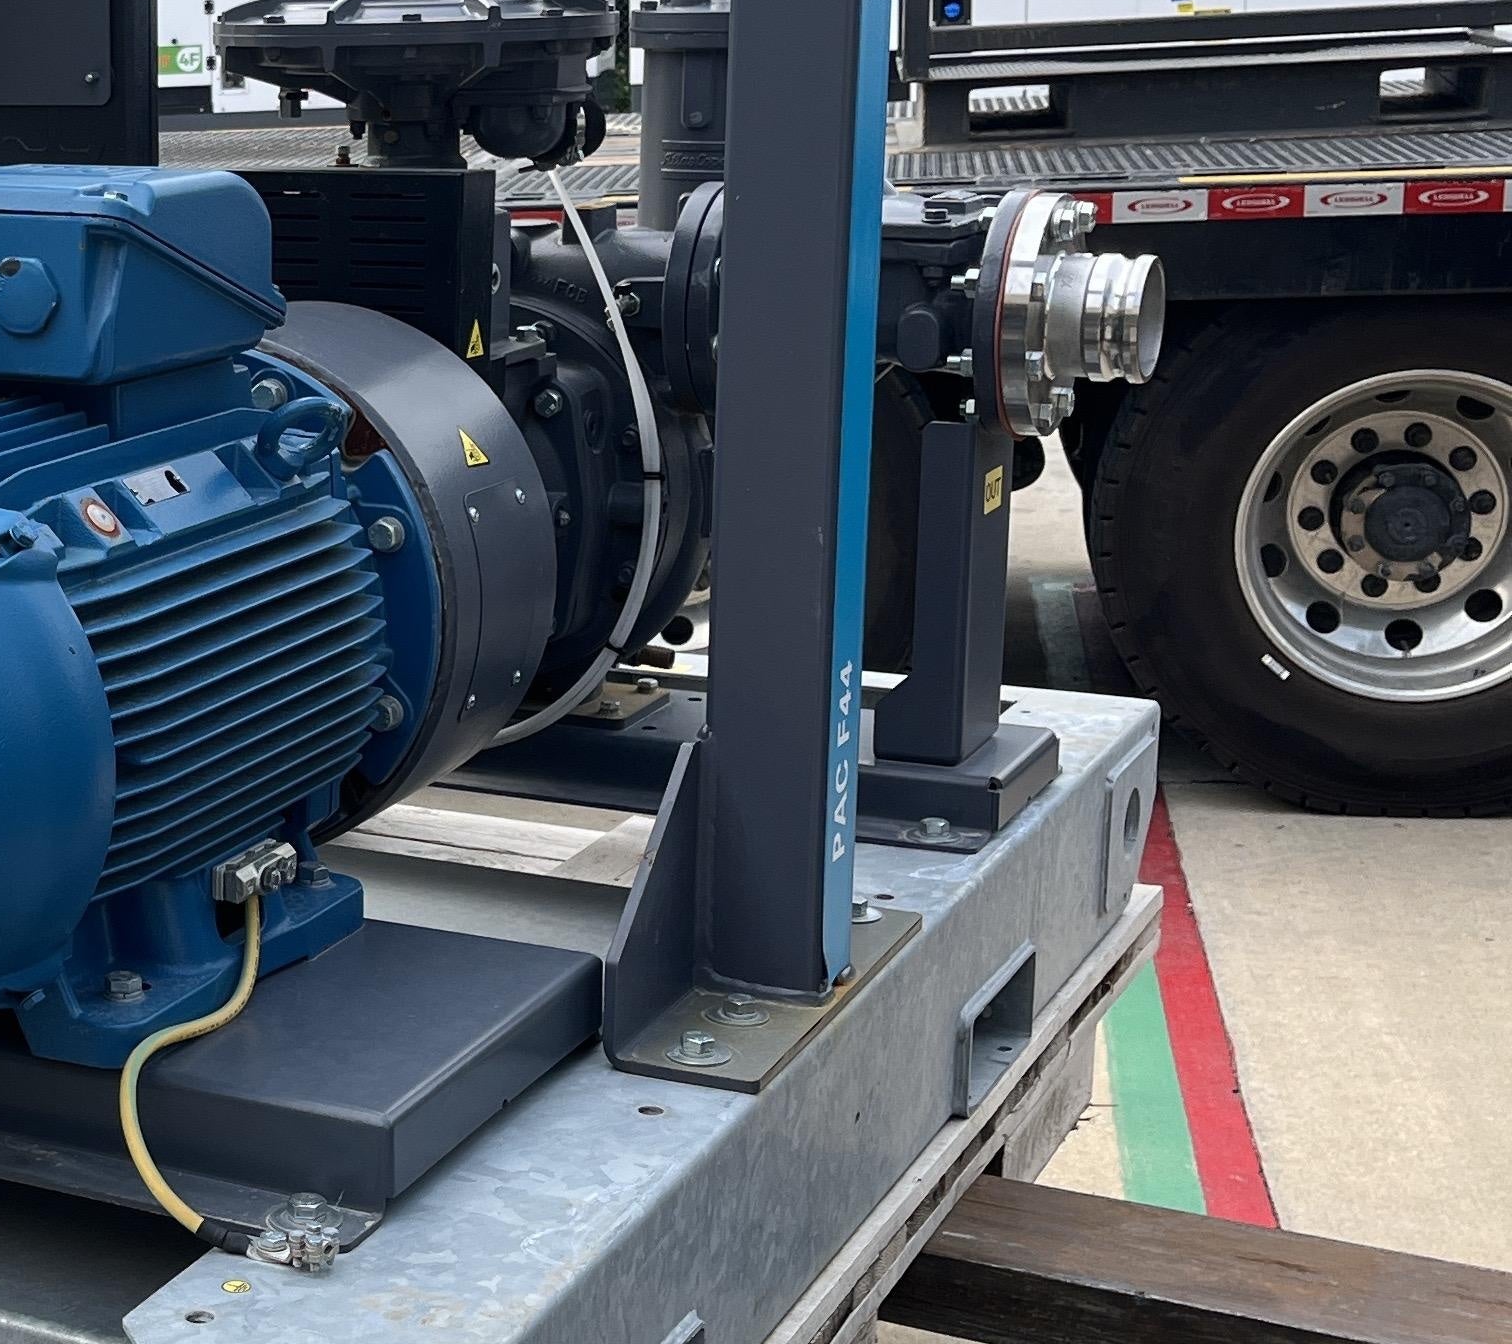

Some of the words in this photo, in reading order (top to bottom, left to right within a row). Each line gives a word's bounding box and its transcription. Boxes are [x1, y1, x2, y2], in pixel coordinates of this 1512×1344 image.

[985, 476, 1002, 502] OUT
[837, 659, 854, 748] F44
[831, 758, 849, 863] PAC
